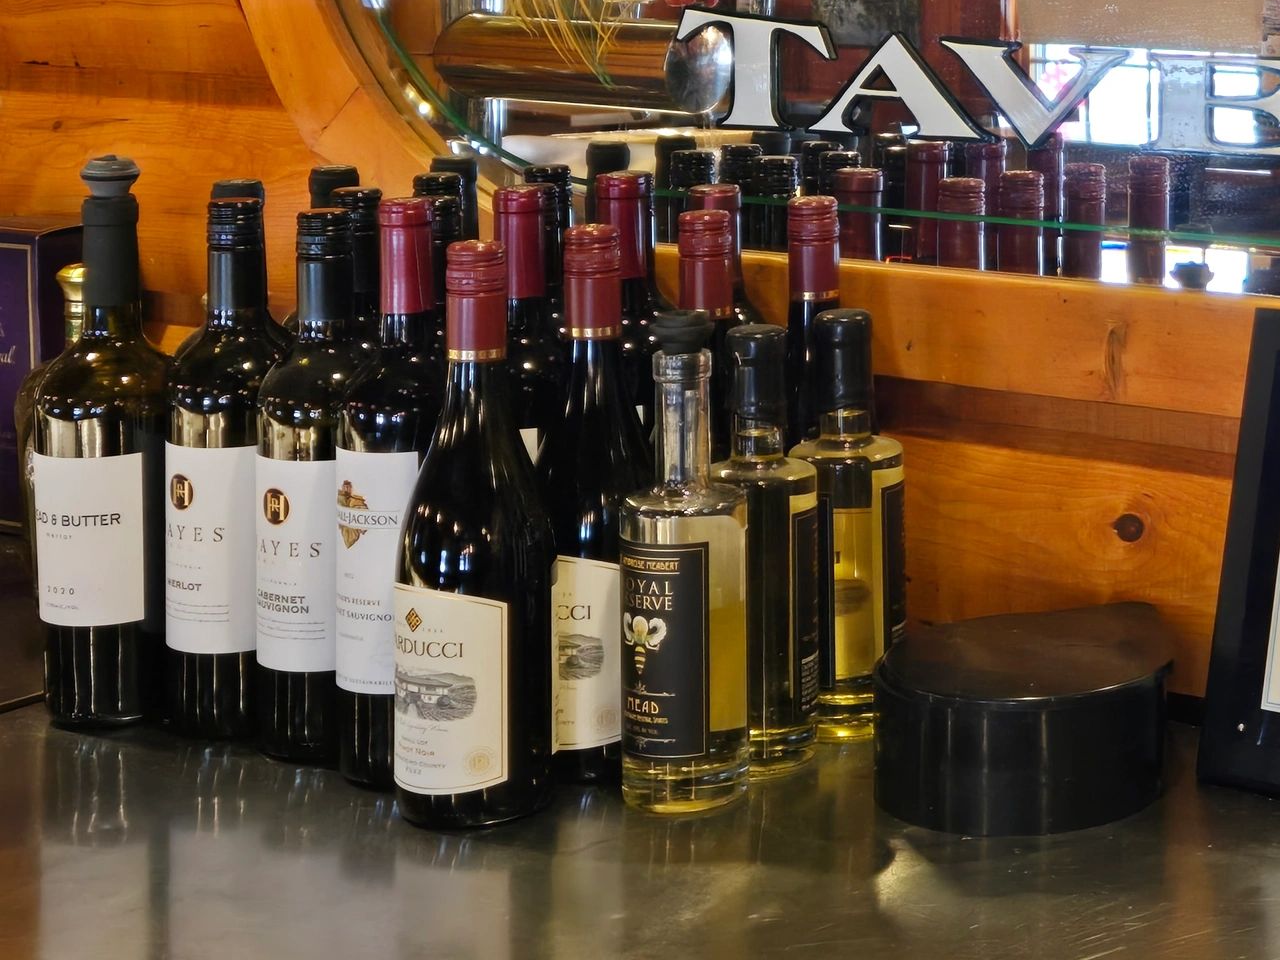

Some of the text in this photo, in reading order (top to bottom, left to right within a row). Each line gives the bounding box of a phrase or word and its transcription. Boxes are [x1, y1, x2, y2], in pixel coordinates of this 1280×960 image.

[51, 514, 57, 526] &
[61, 513, 121, 527] BUTTER
[167, 524, 225, 542] AYES
[260, 539, 321, 557] AYES
[626, 578, 674, 595] OYAL
[257, 588, 306, 604] CABERNET
[628, 593, 673, 611] SERVE
[346, 609, 395, 622] SAUVIGNO
[627, 696, 659, 713] MEAD
